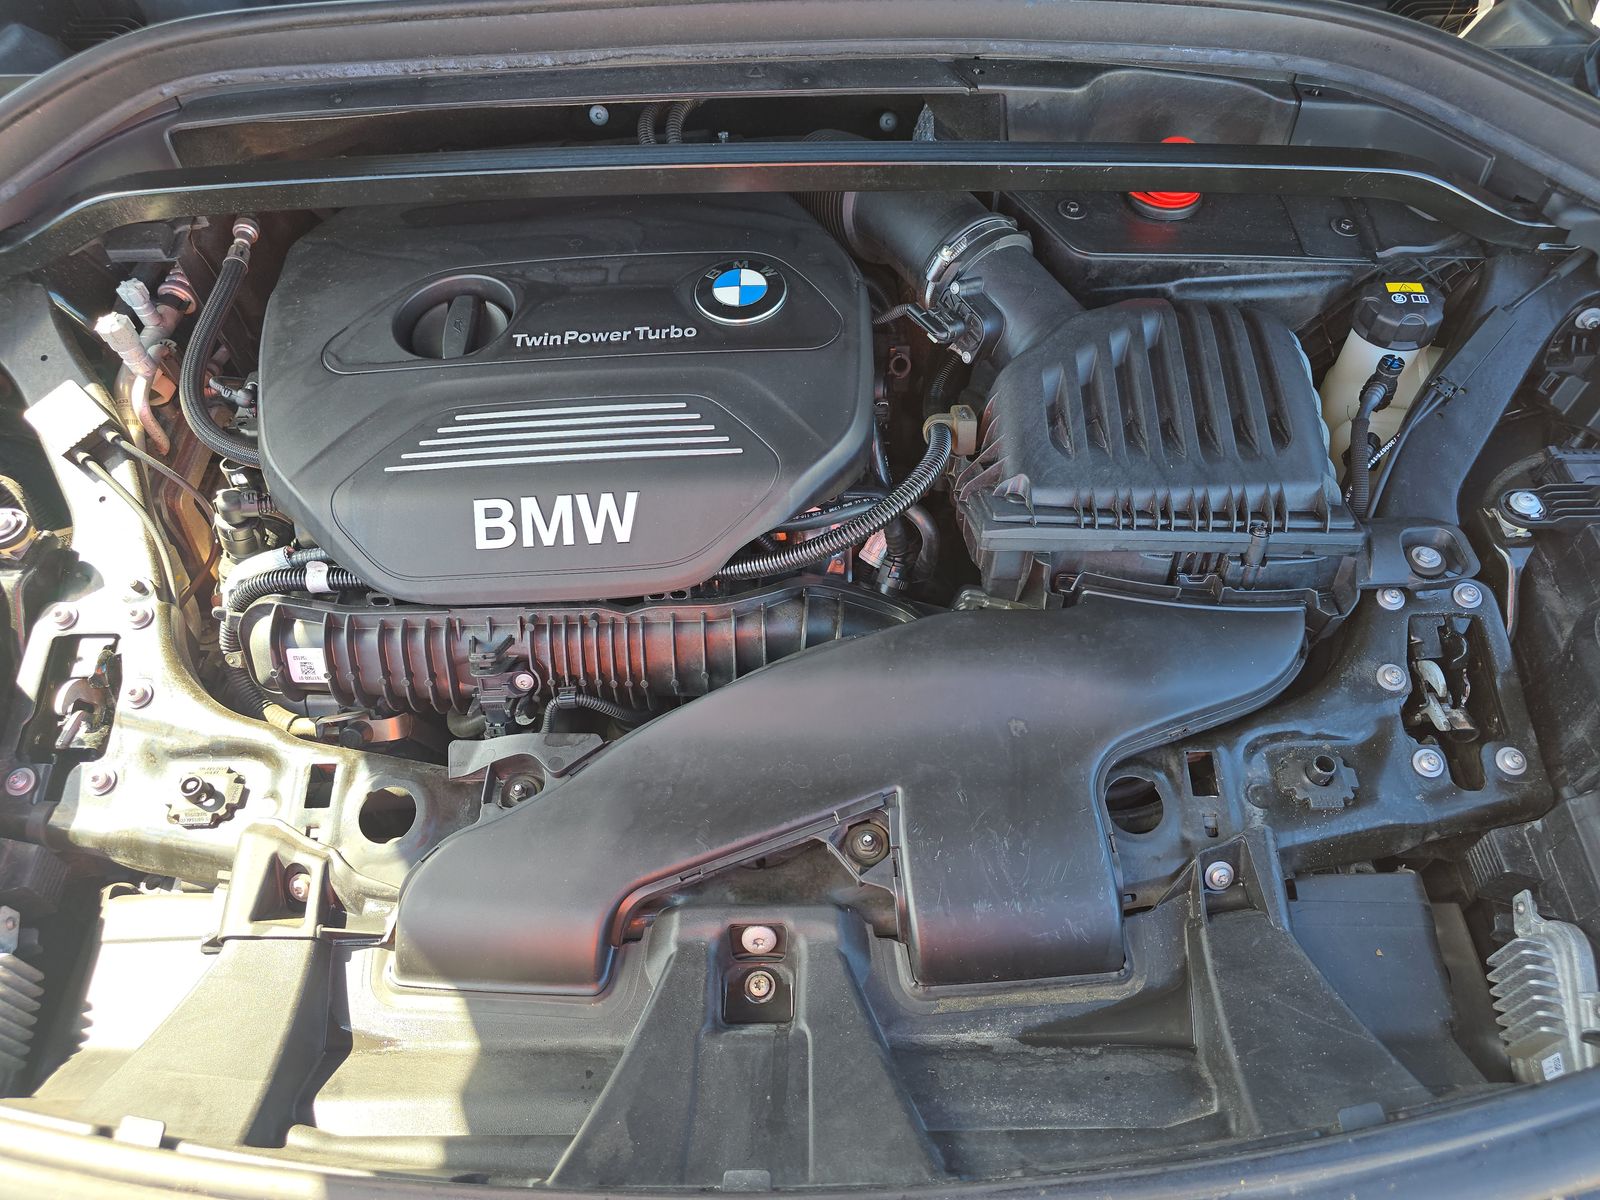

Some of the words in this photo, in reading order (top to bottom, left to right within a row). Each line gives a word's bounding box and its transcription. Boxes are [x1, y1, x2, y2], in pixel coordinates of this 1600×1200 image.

[704, 260, 778, 280] BMW
[634, 325, 698, 341] Turbo
[473, 490, 641, 550] BMW
